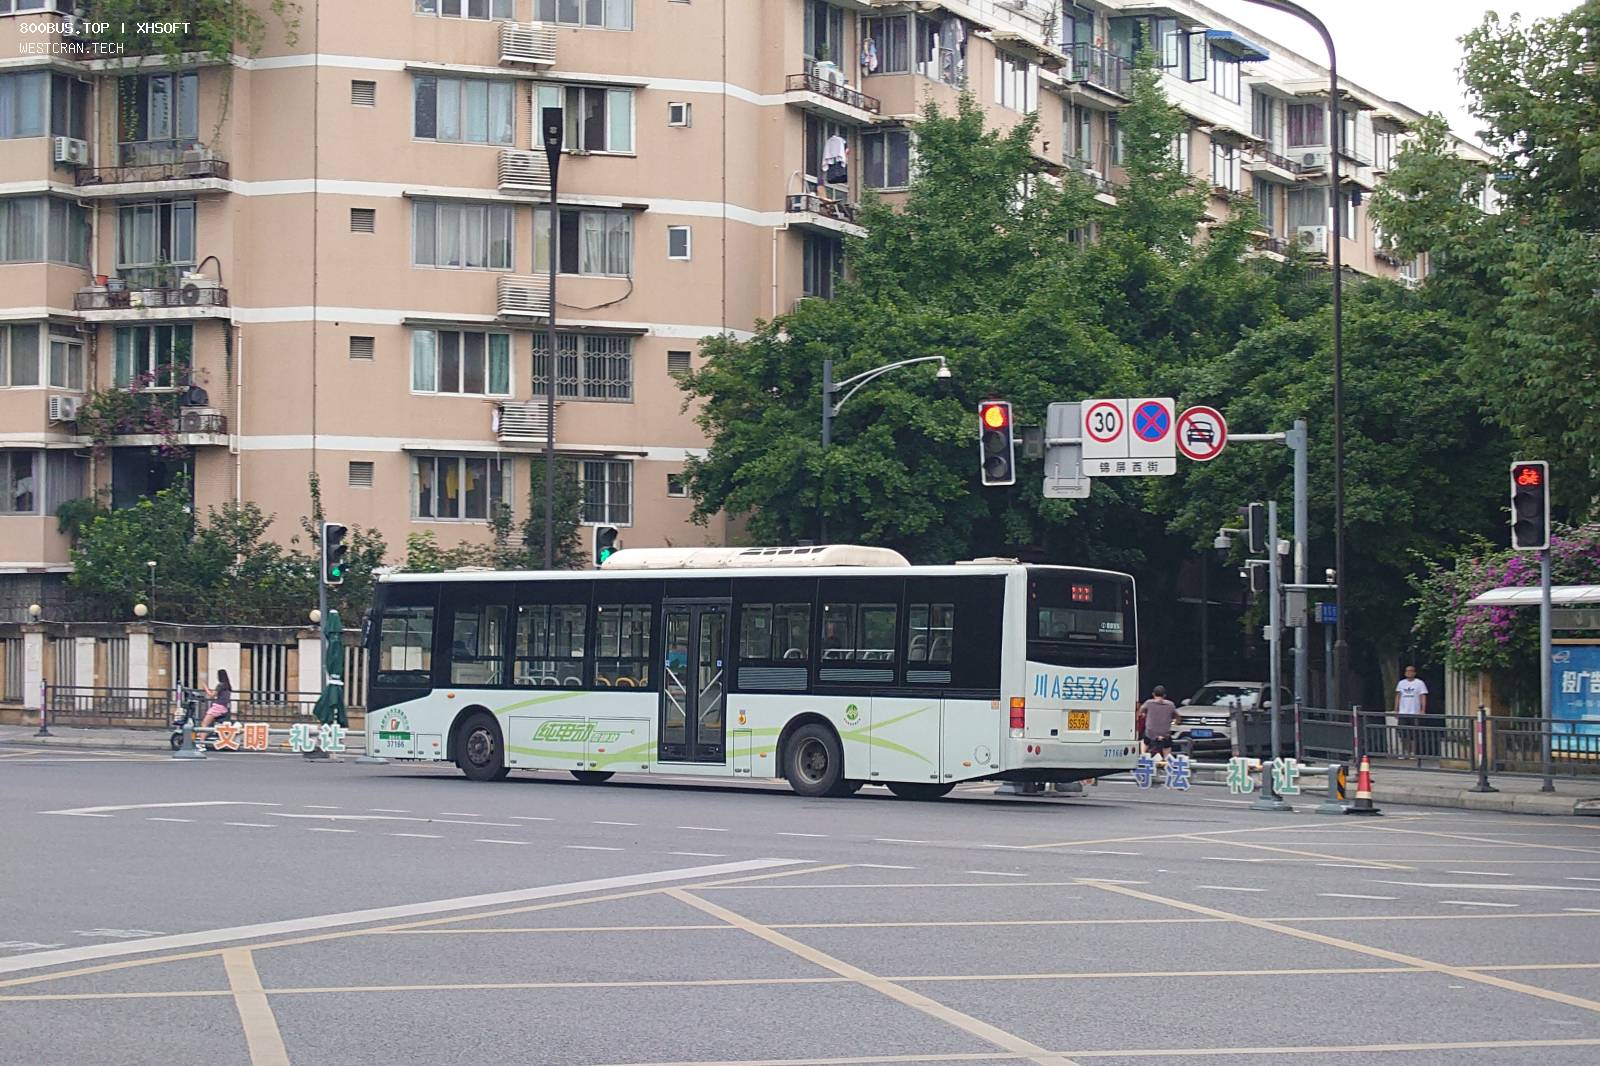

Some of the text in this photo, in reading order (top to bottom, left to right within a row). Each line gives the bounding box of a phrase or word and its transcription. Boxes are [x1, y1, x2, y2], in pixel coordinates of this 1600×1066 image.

[1094, 412, 1115, 433] 30
[1099, 461, 1158, 473] 锦屏西街
[1035, 675, 1118, 700] 川AS5396
[1069, 720, 1088, 729] S5396
[213, 723, 345, 751] 文明 礼让
[1134, 755, 1301, 794] 守法 礼让
